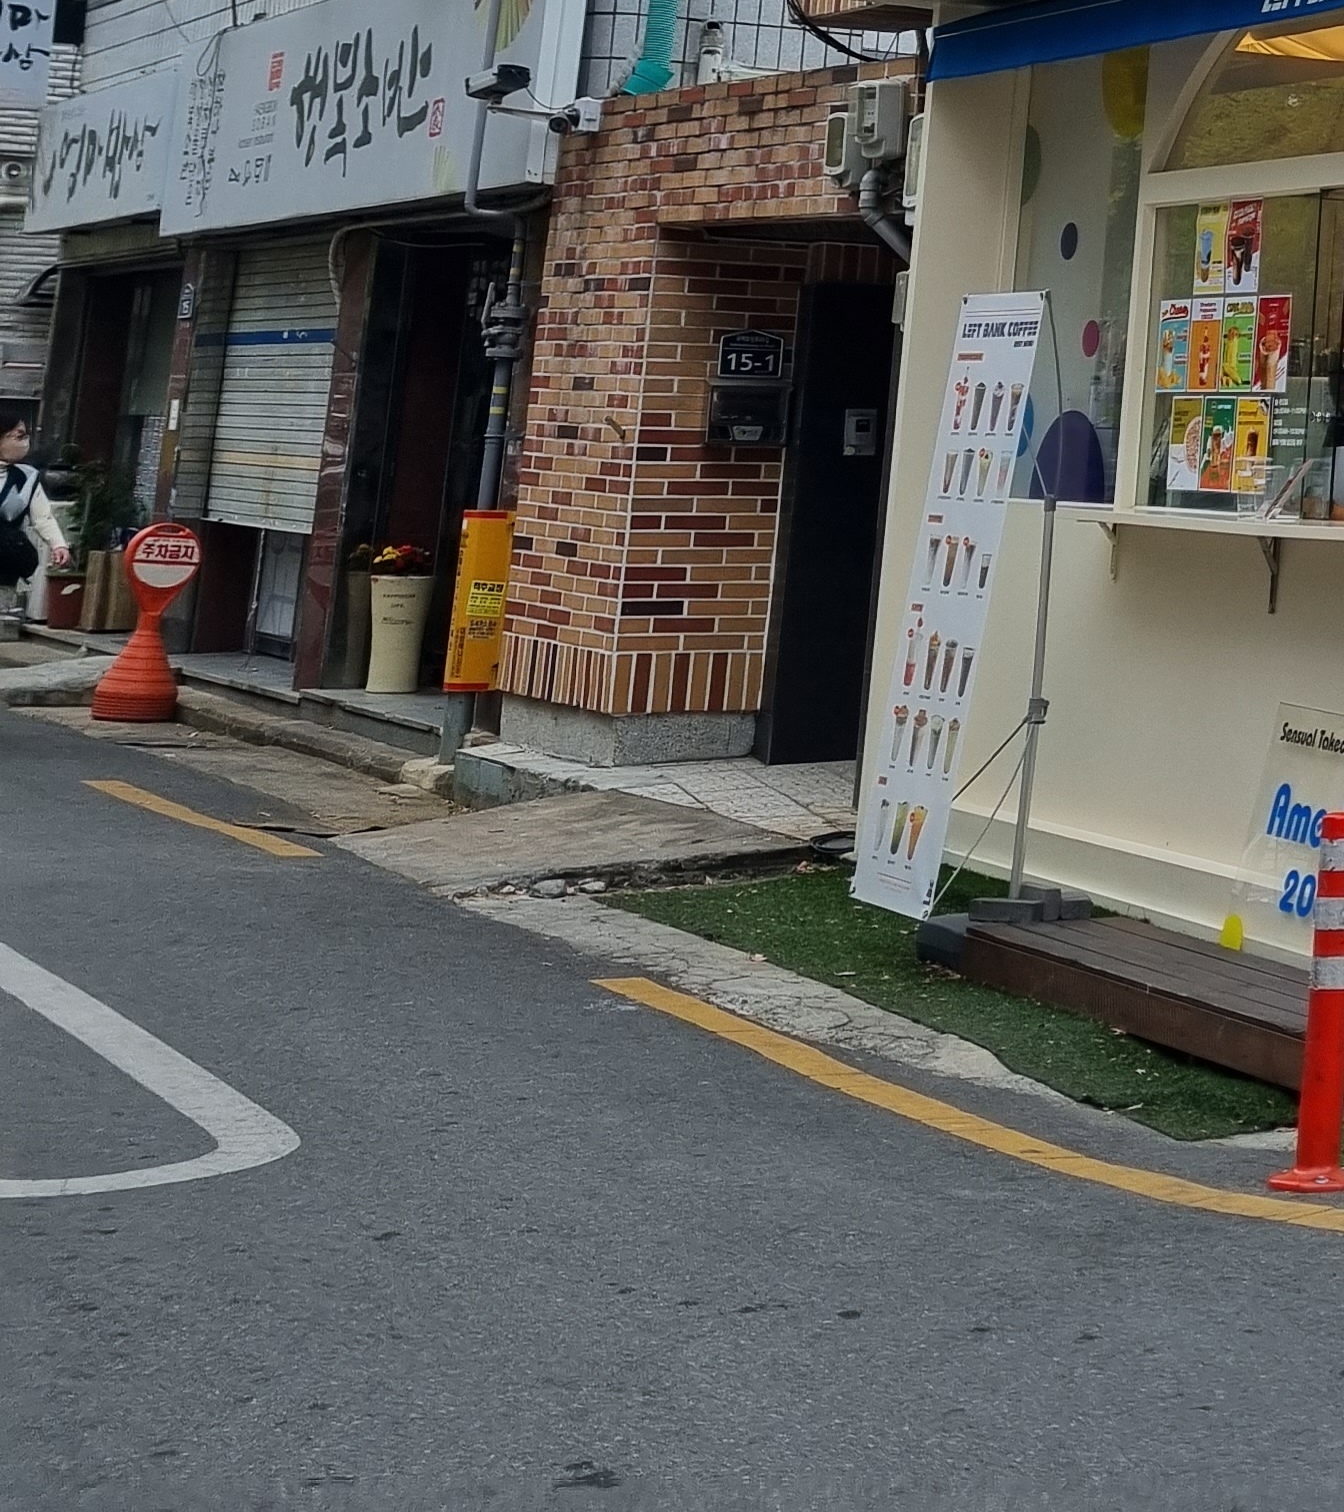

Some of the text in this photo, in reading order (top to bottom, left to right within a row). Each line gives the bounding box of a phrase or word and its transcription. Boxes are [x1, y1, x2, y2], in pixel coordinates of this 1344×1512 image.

[0, 2, 50, 32] 마
[0, 43, 51, 71] 상
[290, 23, 433, 178] 행복소반
[962, 320, 1039, 339] LEFT BANK COFFEE
[726, 352, 775, 372] 15-1
[142, 542, 196, 561] 주차금지
[1279, 721, 1317, 748] Sensual
